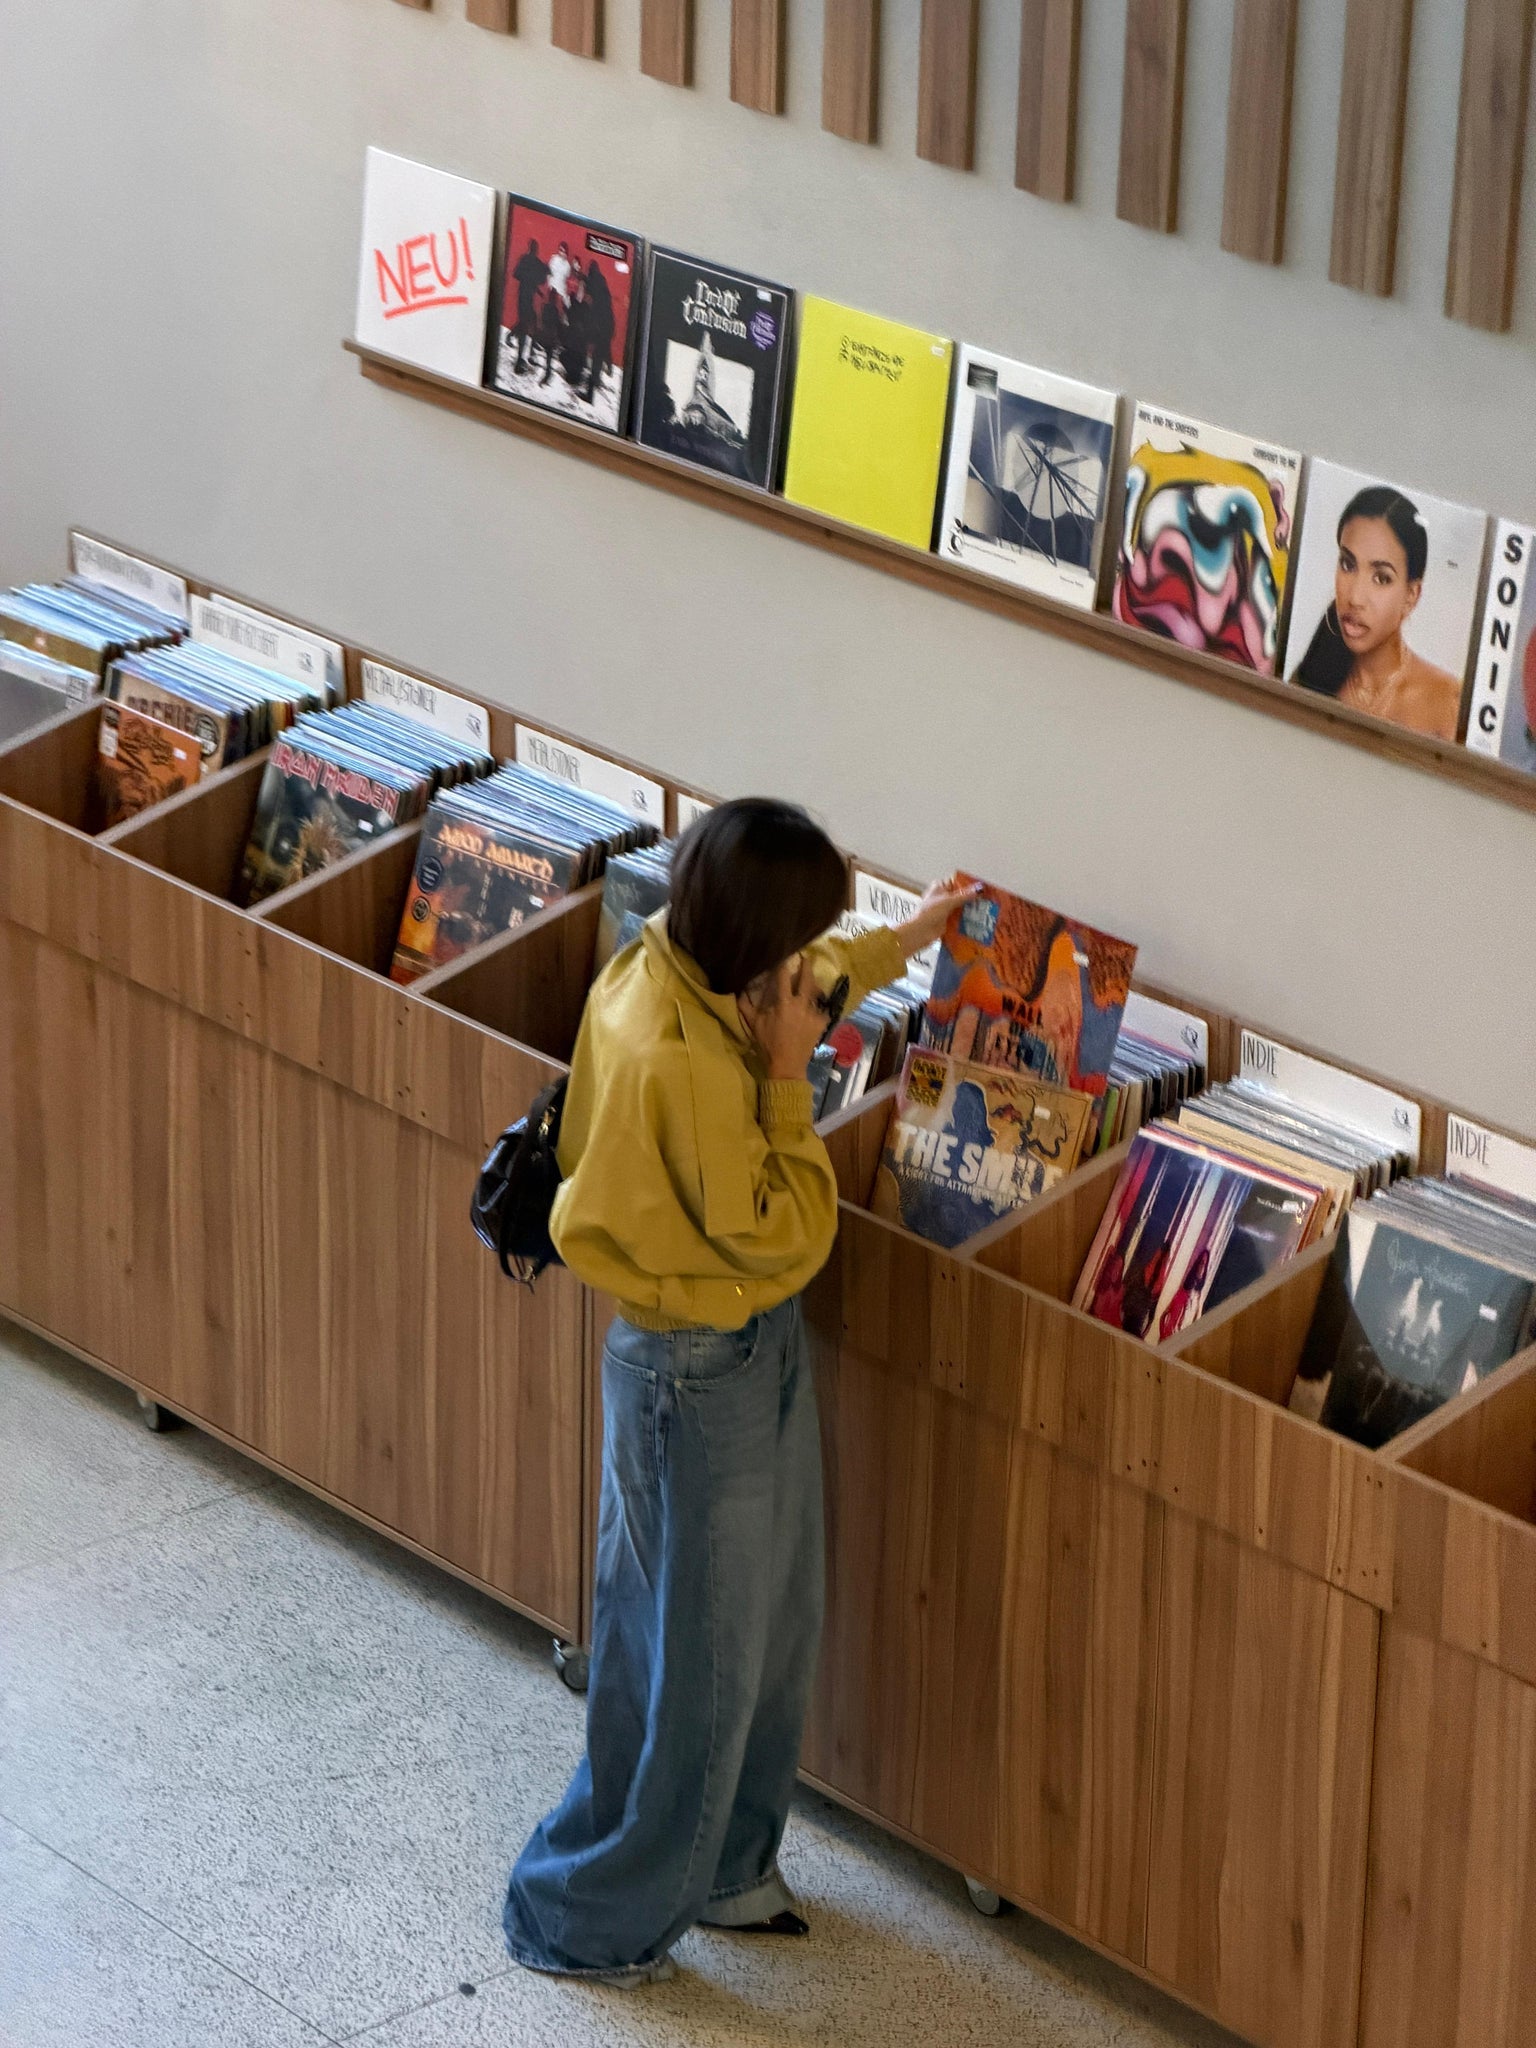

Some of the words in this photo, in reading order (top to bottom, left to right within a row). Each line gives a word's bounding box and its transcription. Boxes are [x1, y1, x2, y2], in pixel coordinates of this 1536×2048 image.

[374, 217, 474, 304] NEU!
[1478, 533, 1524, 733] SONIC
[1243, 1034, 1278, 1078] INDIE
[895, 1121, 959, 1178] THE
[1450, 1118, 1489, 1166] INDIE
